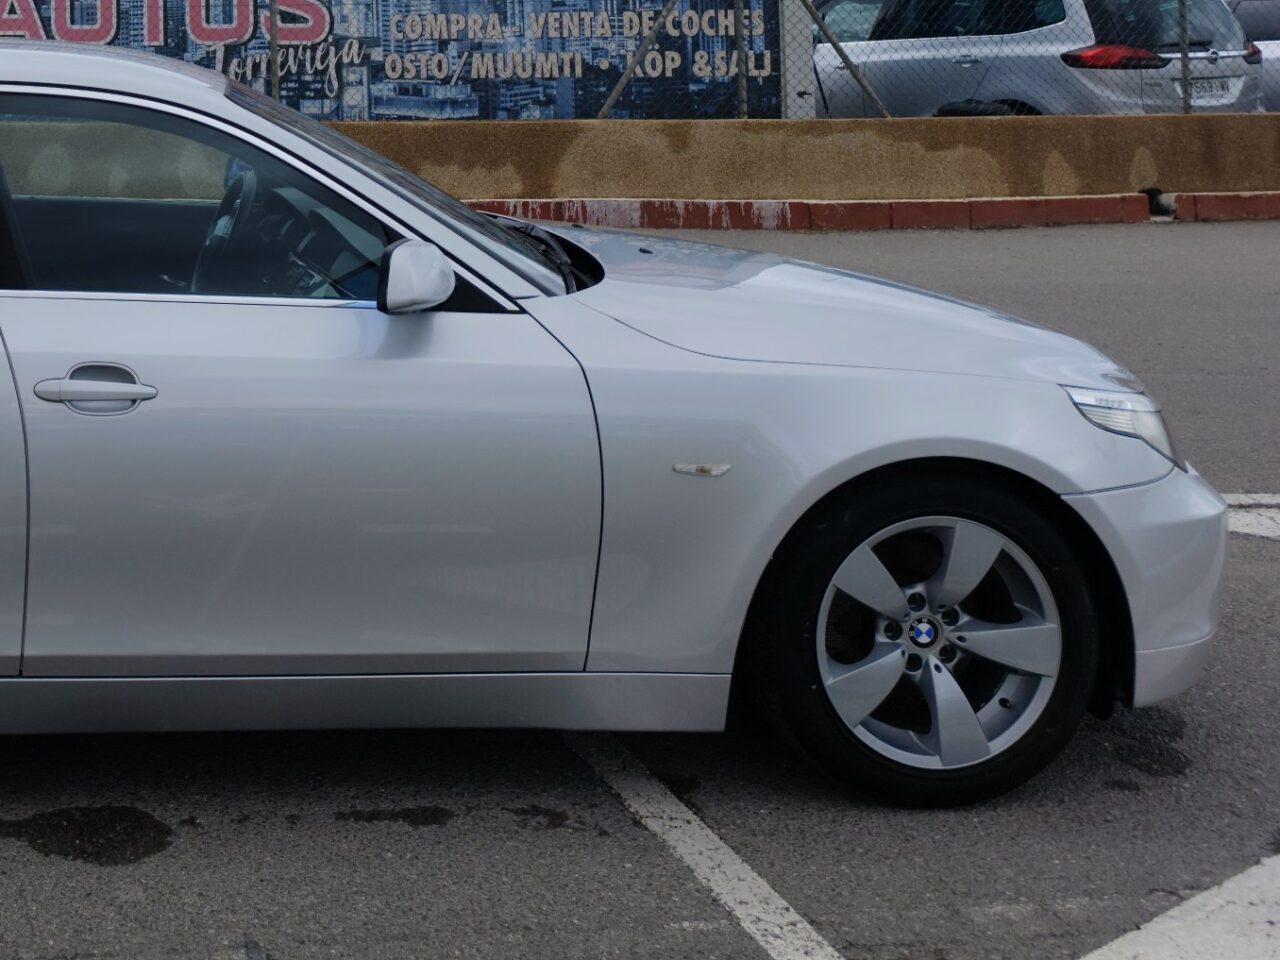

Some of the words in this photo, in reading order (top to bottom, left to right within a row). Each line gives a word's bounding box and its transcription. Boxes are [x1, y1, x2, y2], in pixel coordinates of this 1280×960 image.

[390, 13, 505, 41] COMPRA
[528, 11, 613, 39] VENTA
[622, 10, 656, 38] DE
[664, 9, 765, 37] COCHES
[384, 51, 583, 86] OSTO/MUUMTI
